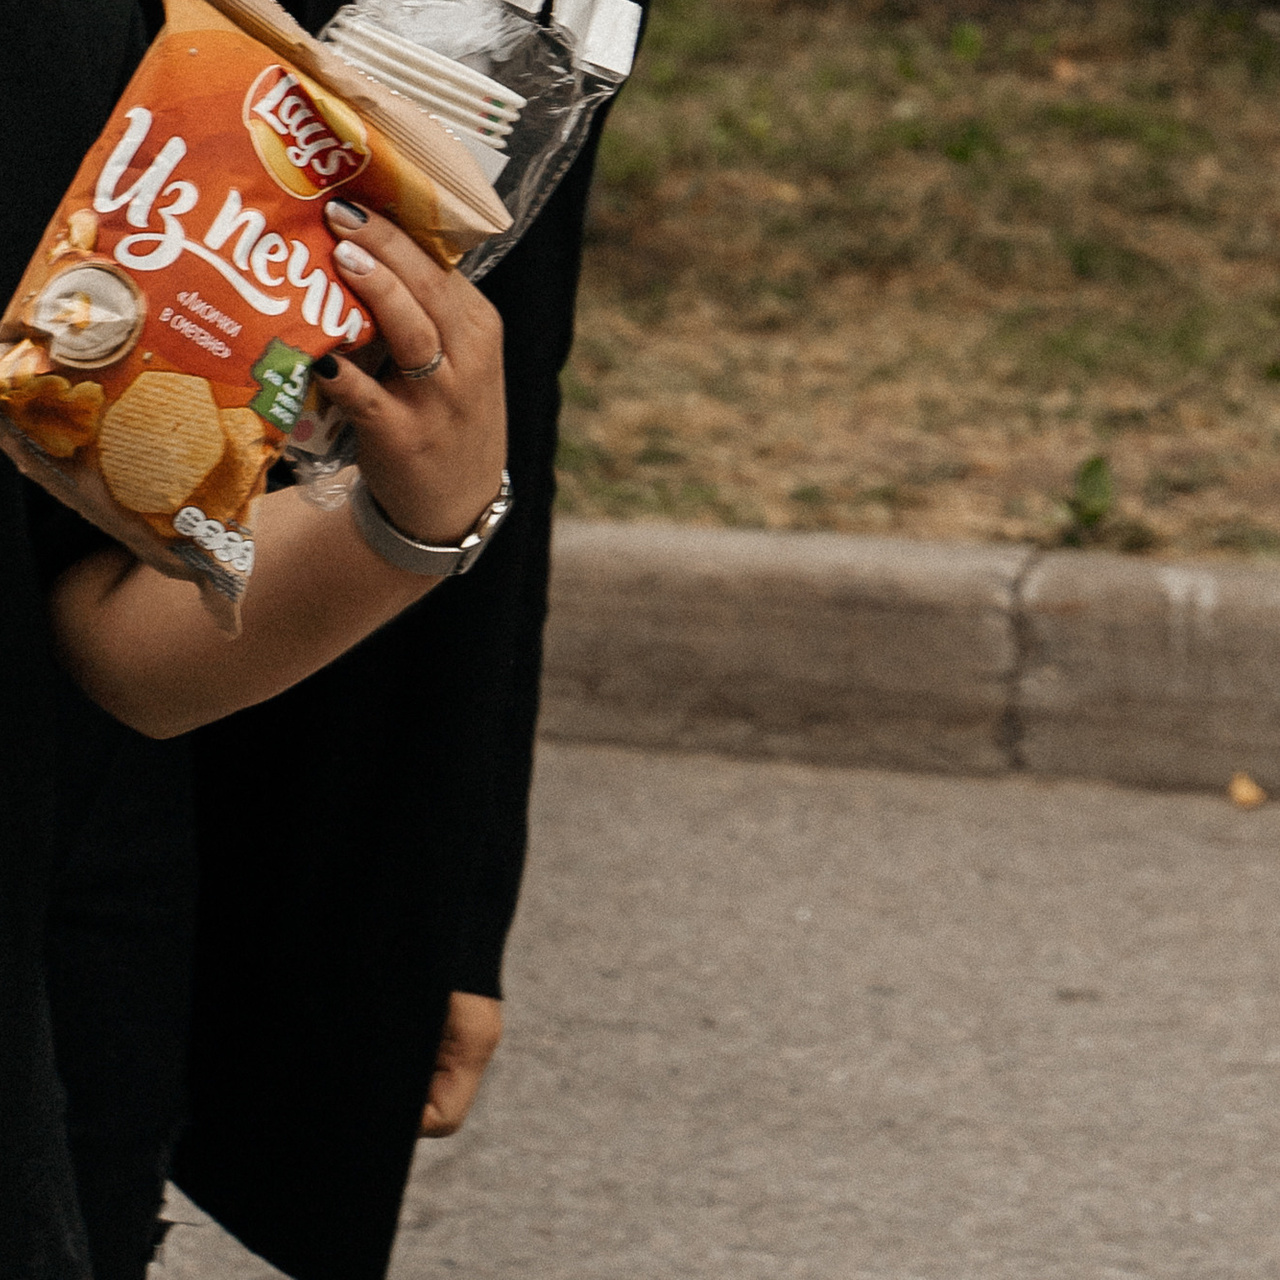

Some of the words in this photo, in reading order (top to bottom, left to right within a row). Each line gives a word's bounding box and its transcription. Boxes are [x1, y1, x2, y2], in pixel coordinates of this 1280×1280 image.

[252, 72, 358, 176] Lay's
[93, 106, 290, 316] Из
[203, 189, 363, 342] печи
